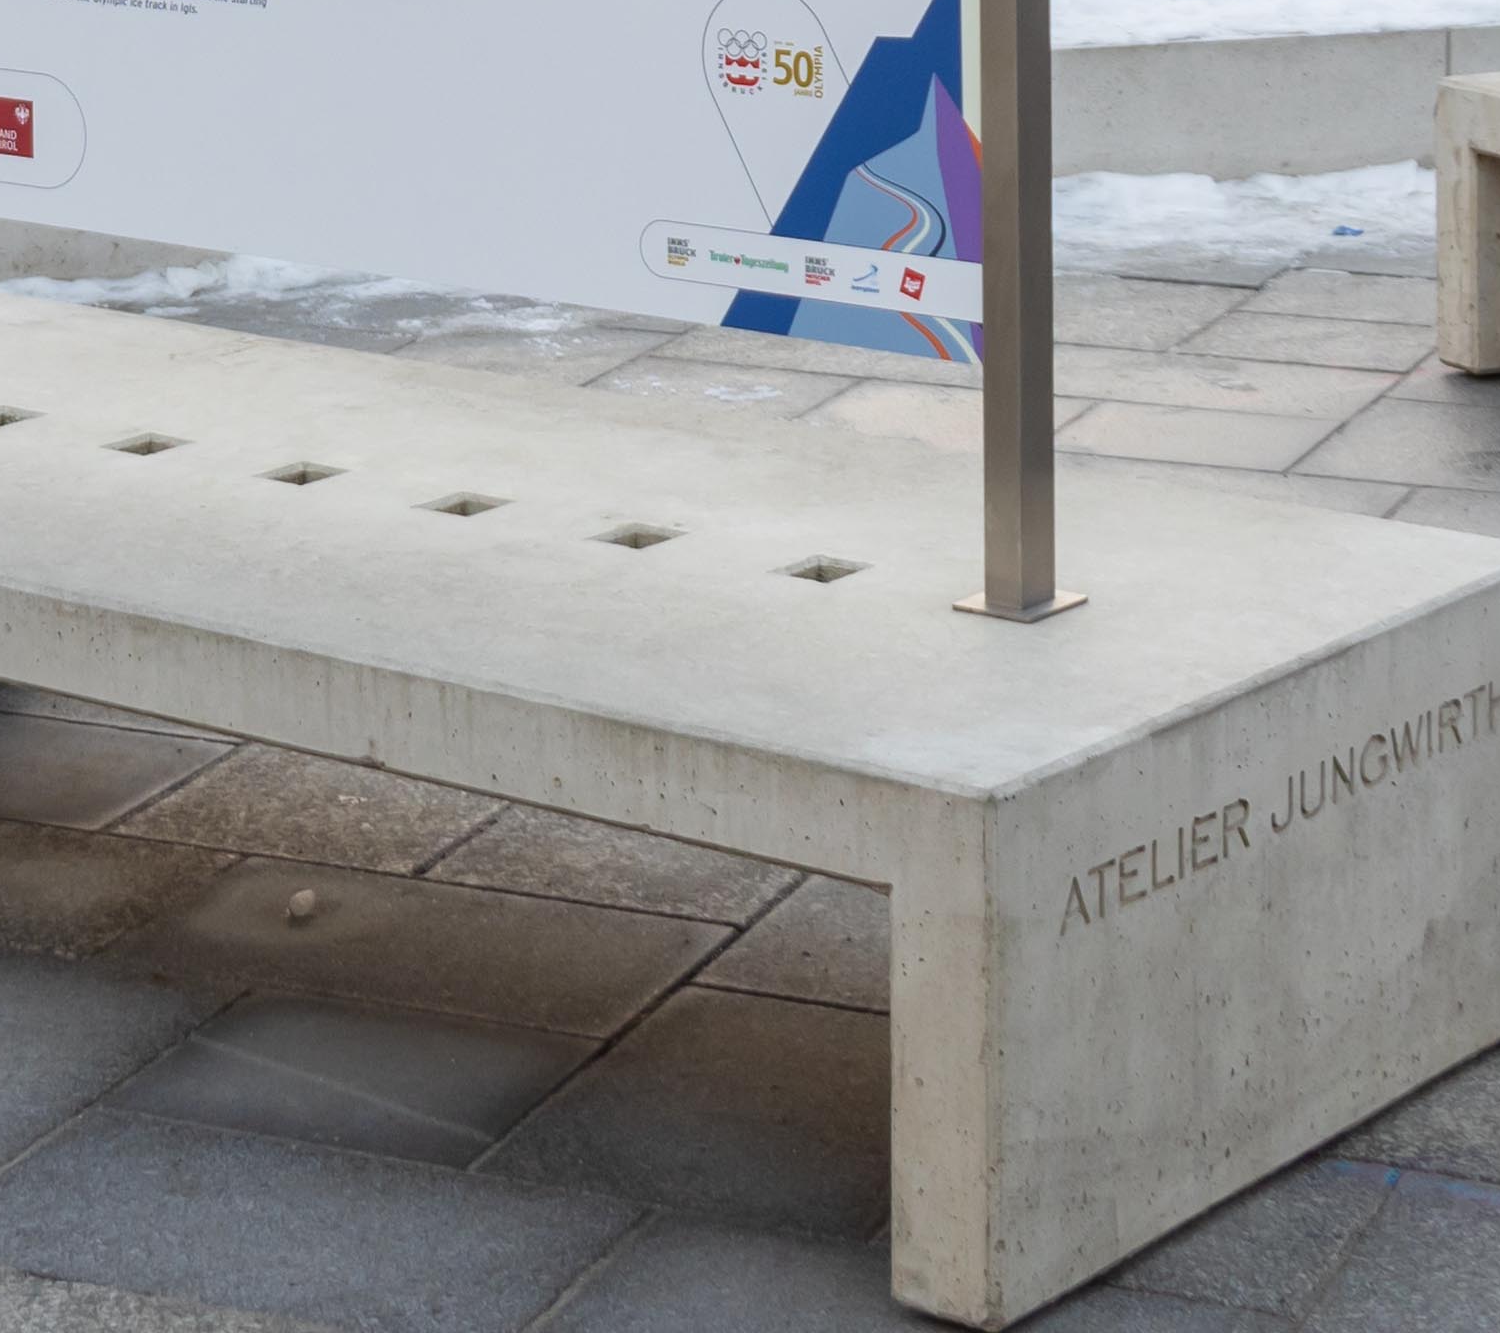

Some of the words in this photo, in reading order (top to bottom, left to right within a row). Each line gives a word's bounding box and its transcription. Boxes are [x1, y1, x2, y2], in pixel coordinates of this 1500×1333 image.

[170, 1, 179, 11] in
[773, 49, 814, 88] 50
[813, 45, 824, 99] OLYMPIA
[1060, 798, 1252, 936] ATELIER
